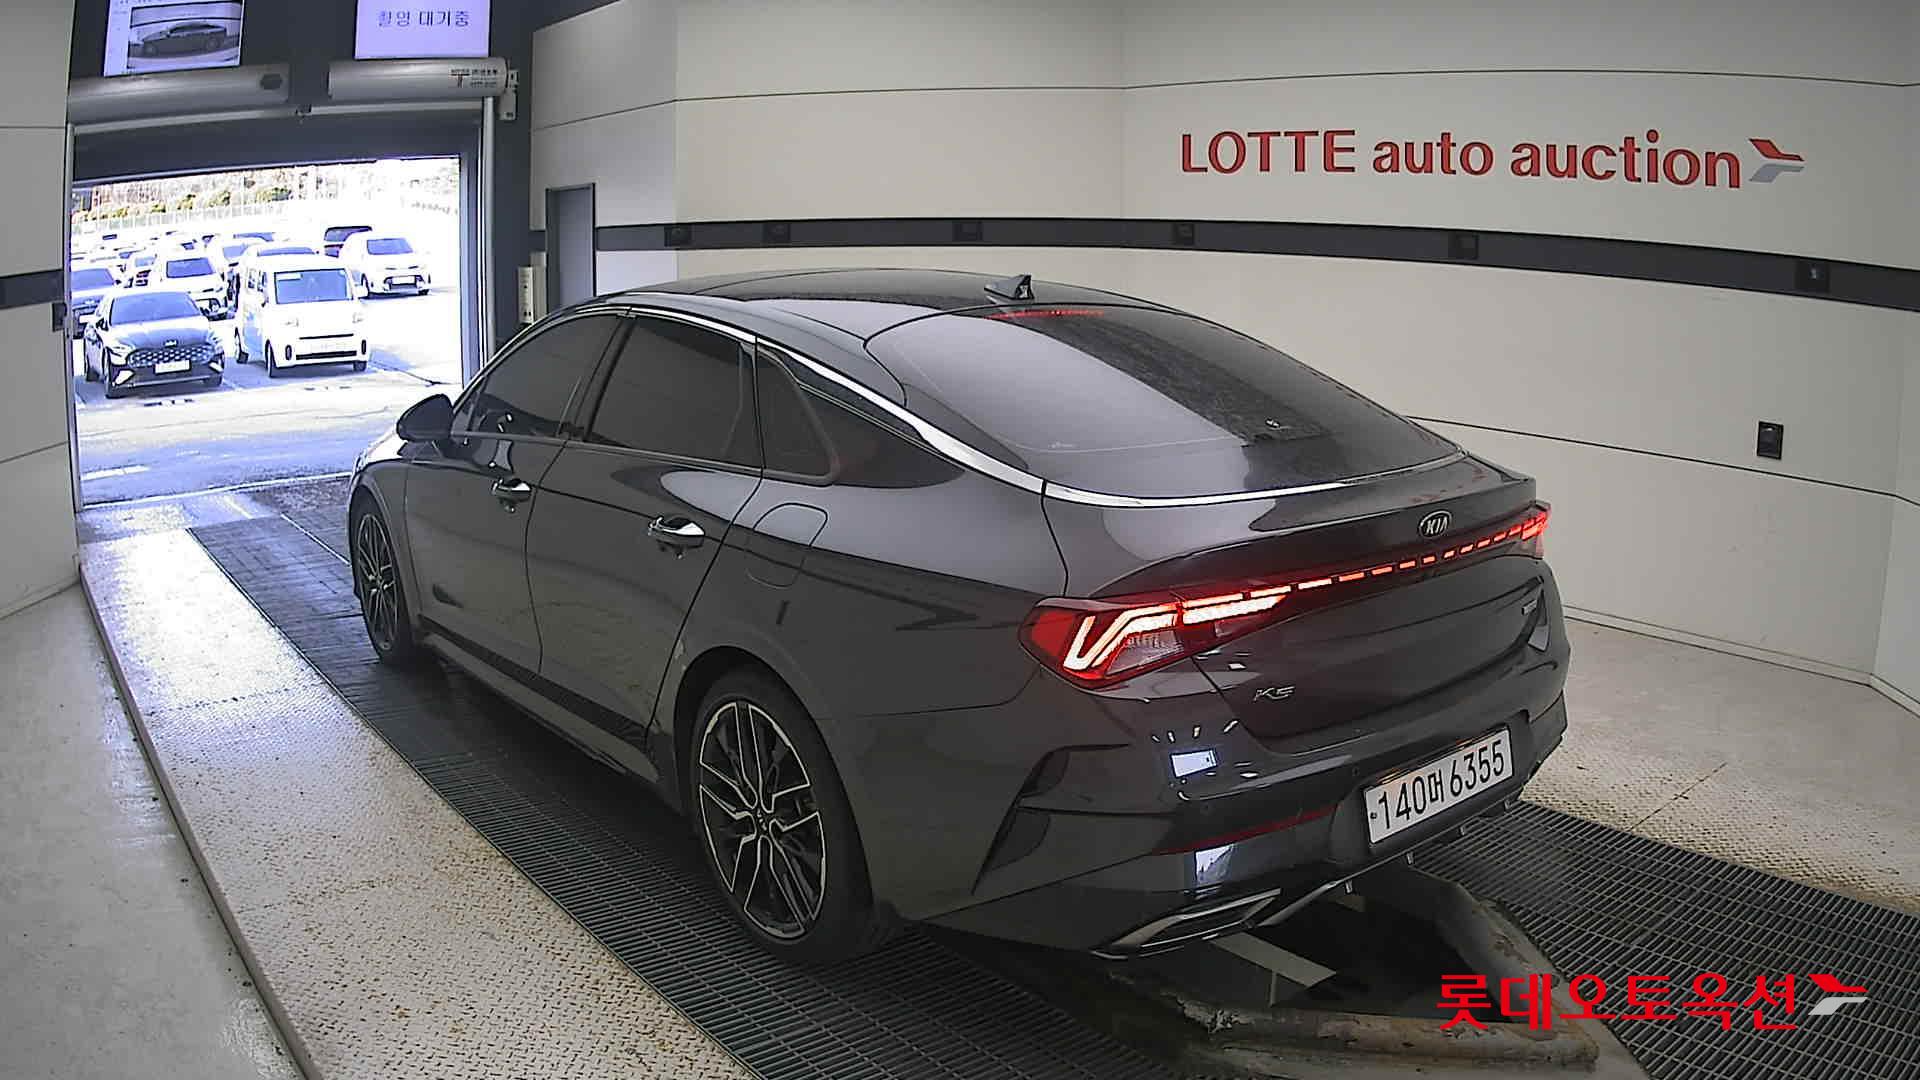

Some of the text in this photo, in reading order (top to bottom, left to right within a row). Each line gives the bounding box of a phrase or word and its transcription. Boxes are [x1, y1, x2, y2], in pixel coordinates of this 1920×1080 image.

[1181, 129, 1742, 189] LOTTE auto auction
[1254, 686, 1295, 701] K5
[1378, 739, 1505, 839] 140머 6355
